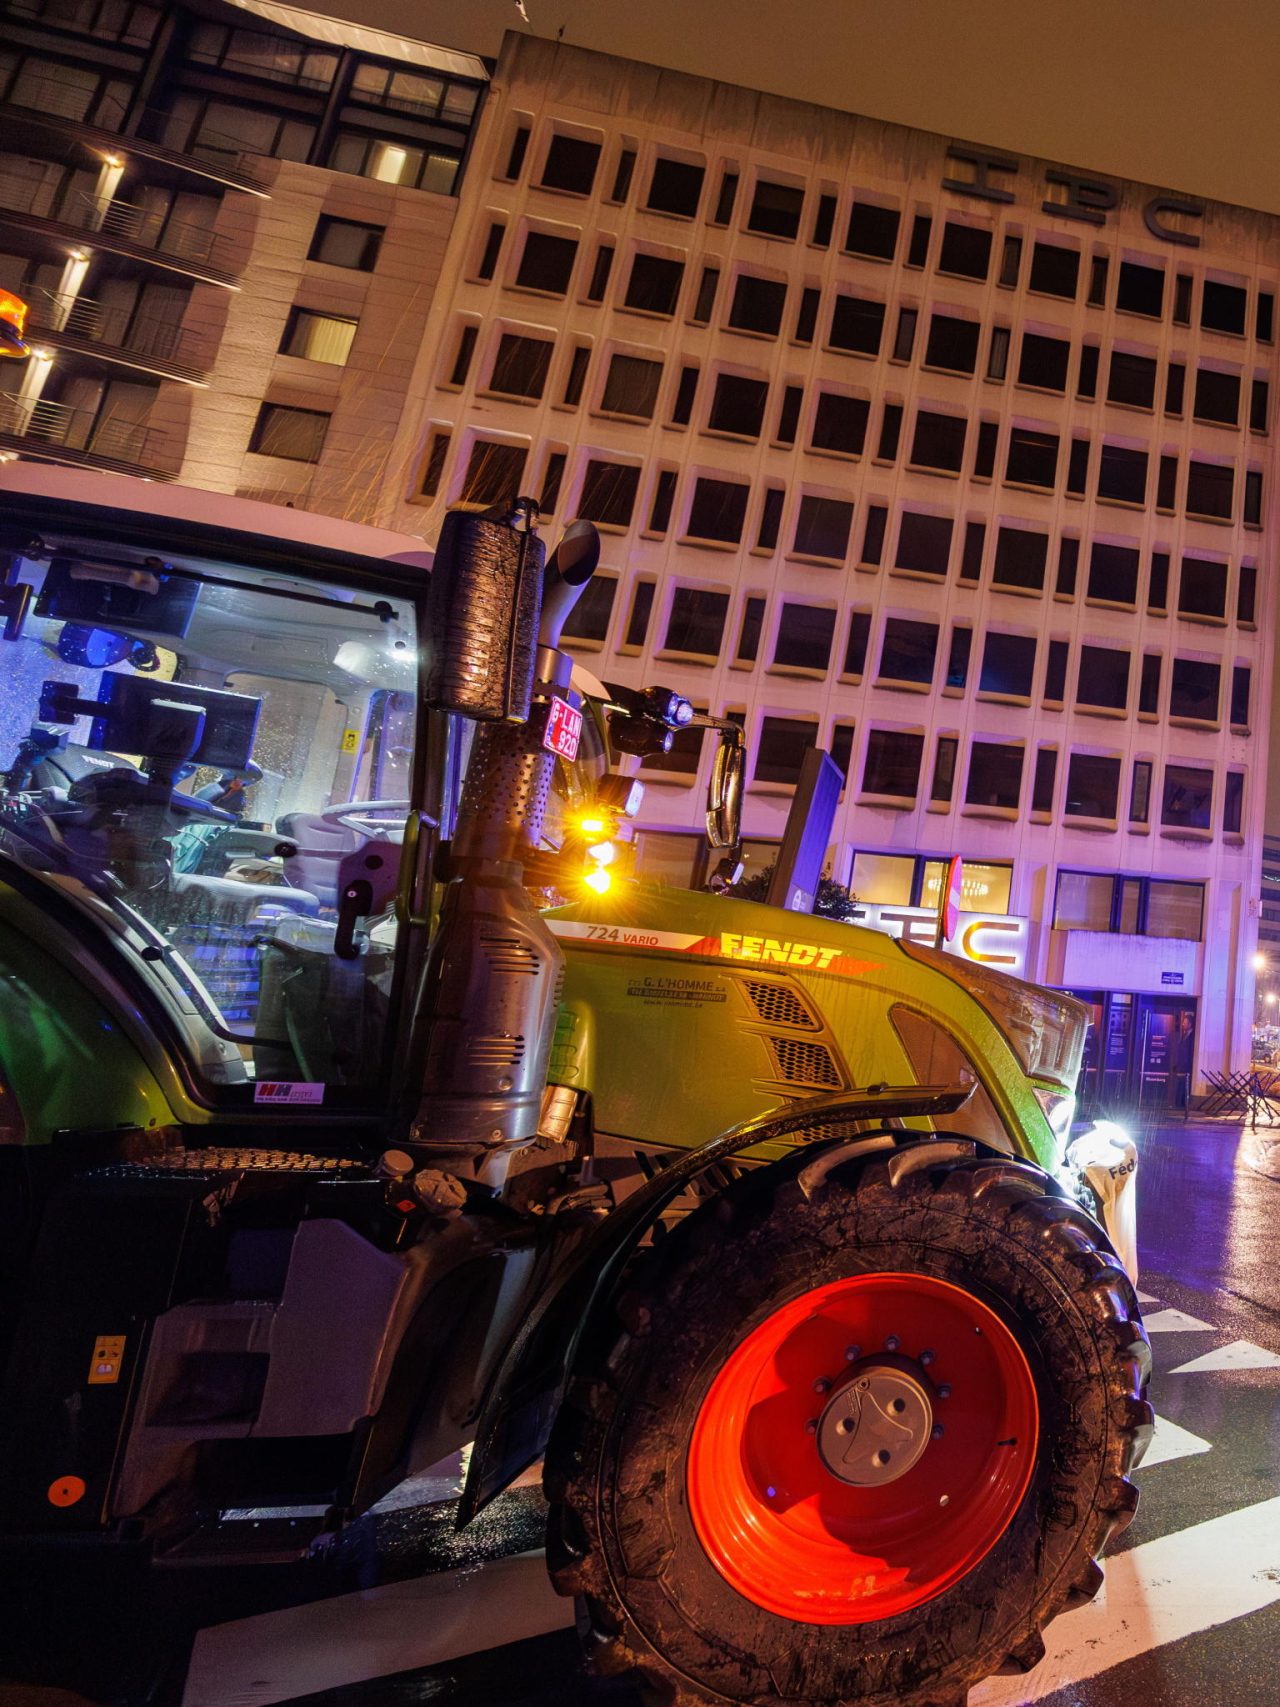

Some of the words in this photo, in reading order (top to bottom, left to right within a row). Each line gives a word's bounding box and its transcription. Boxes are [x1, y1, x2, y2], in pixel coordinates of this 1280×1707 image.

[586, 925, 620, 942] 724
[623, 933, 659, 946] VARIO
[720, 931, 844, 969] FENDT
[1108, 1158, 1138, 1180] Féd
